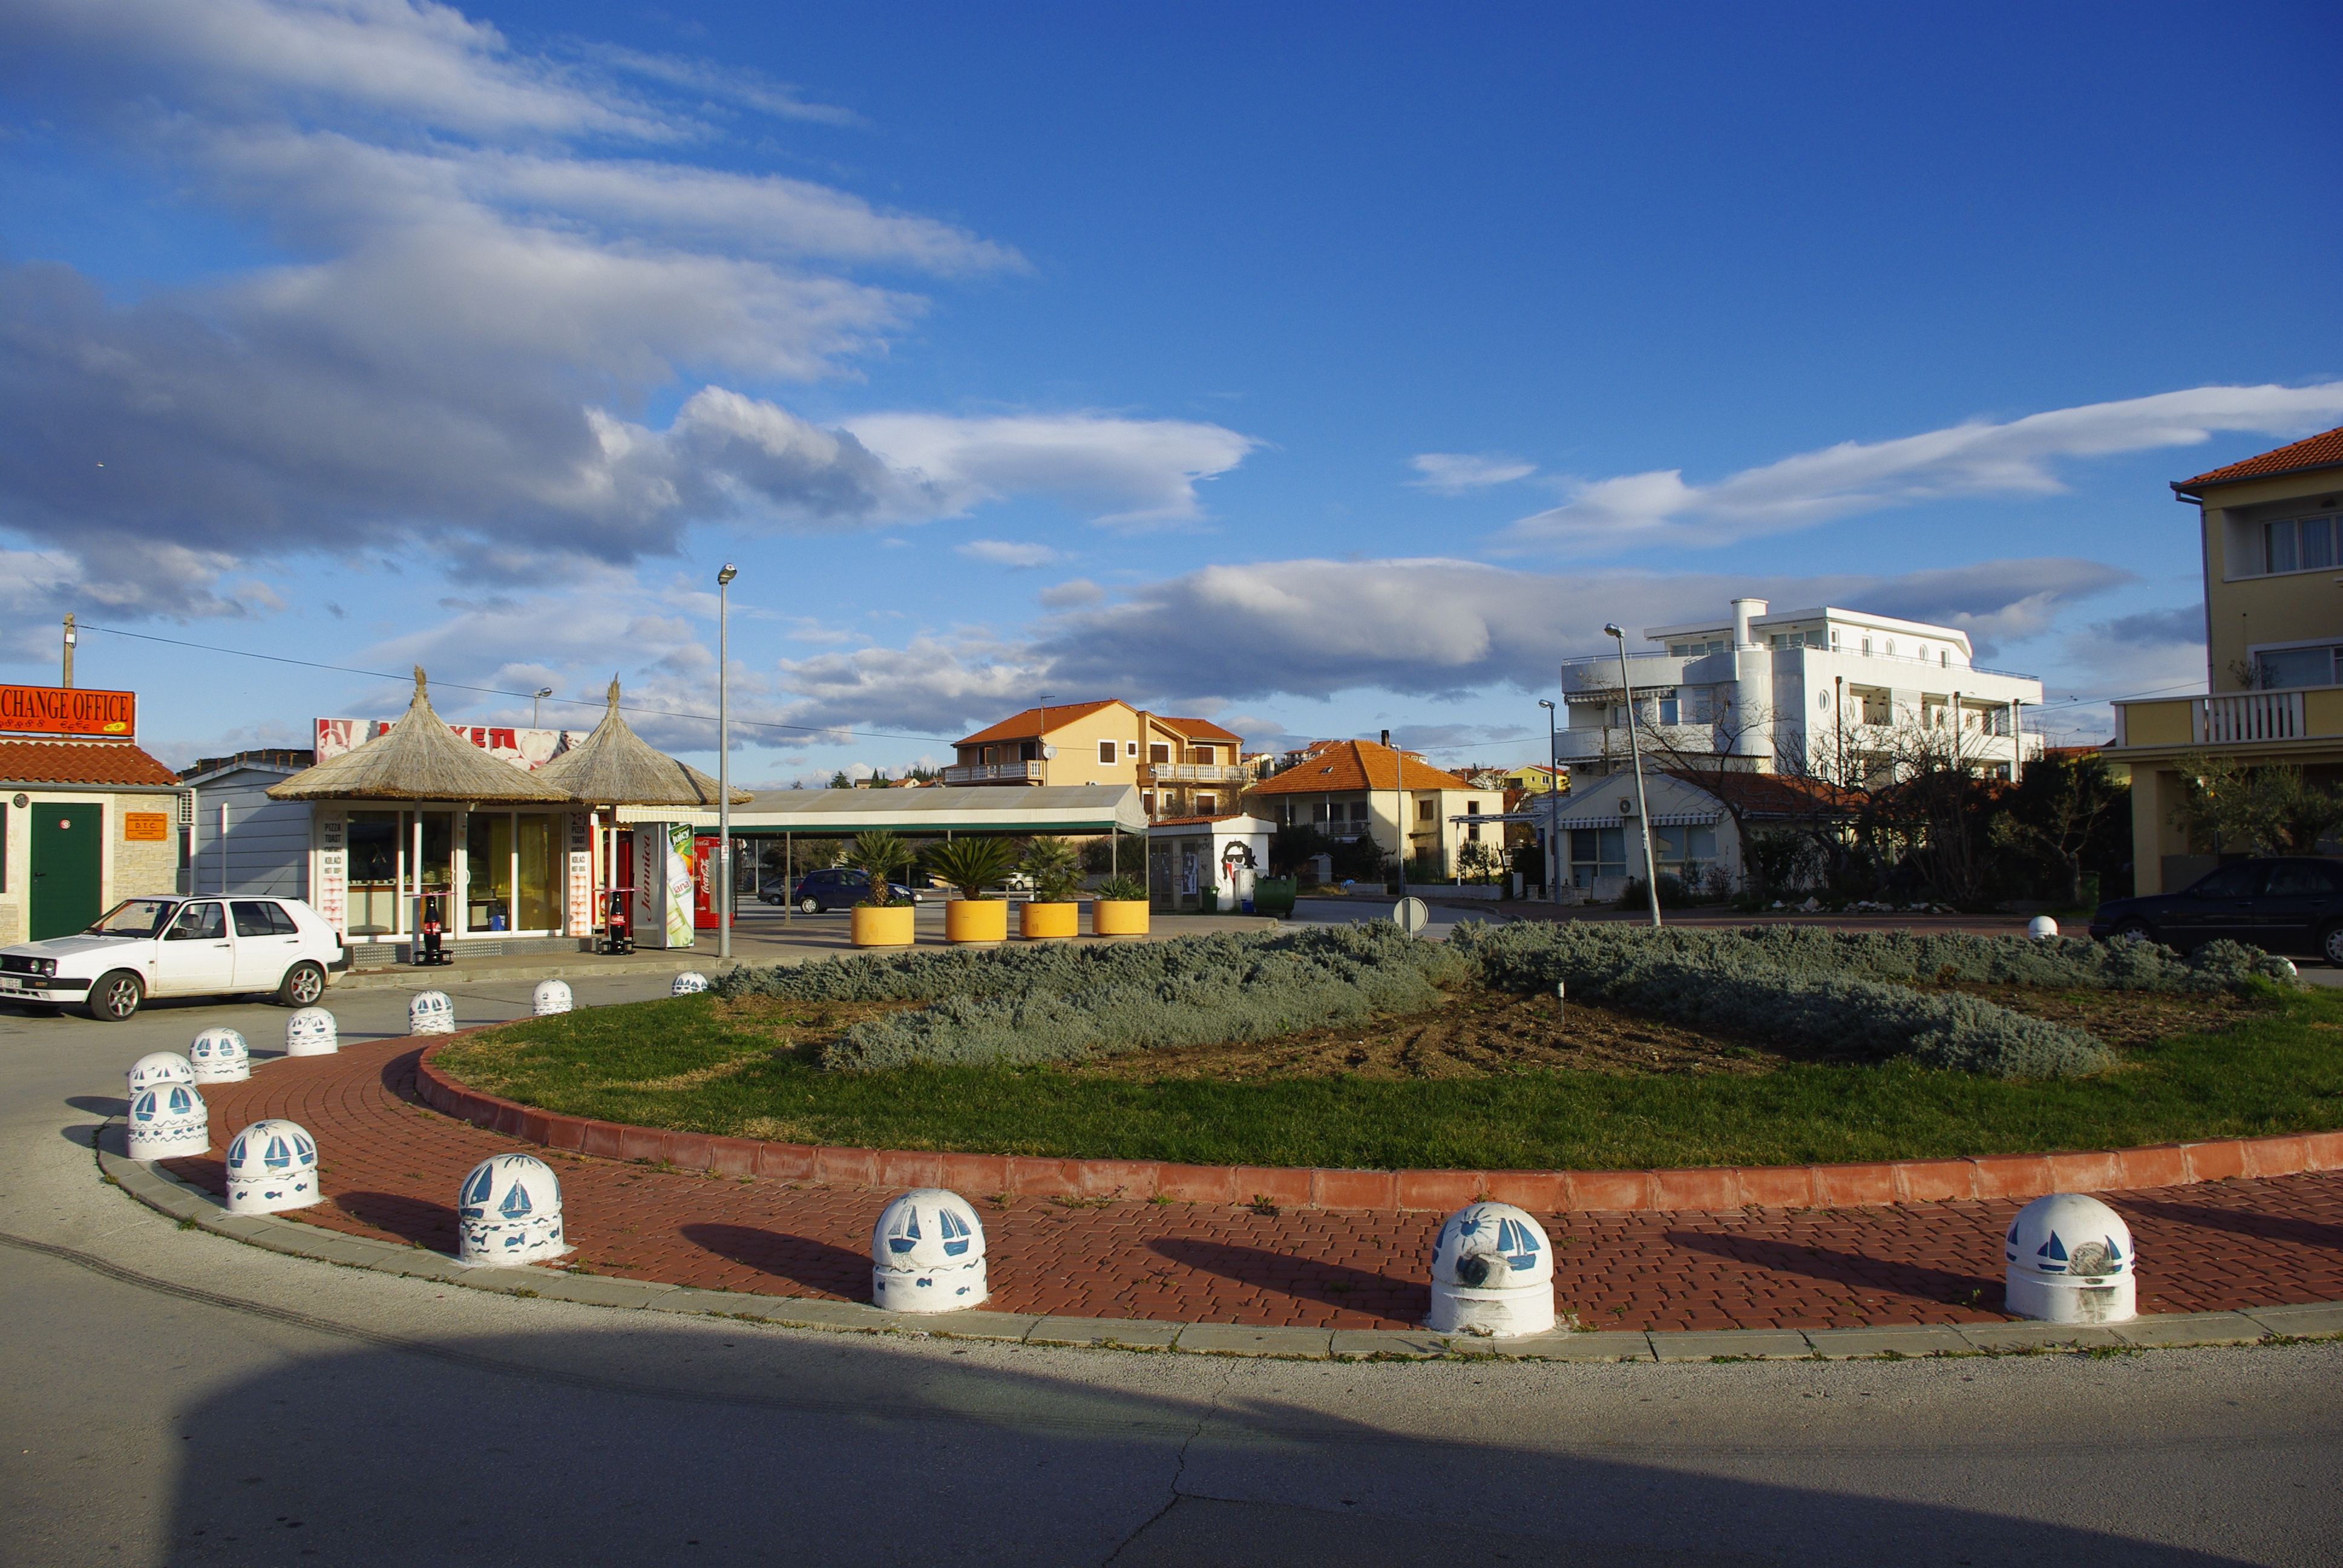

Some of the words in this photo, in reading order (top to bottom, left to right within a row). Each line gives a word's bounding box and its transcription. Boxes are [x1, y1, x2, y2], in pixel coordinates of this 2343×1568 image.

[0, 688, 68, 719] CHANGE
[73, 693, 128, 722] OFFICE
[672, 829, 690, 846] Juicy
[641, 834, 652, 923] Jamnica
